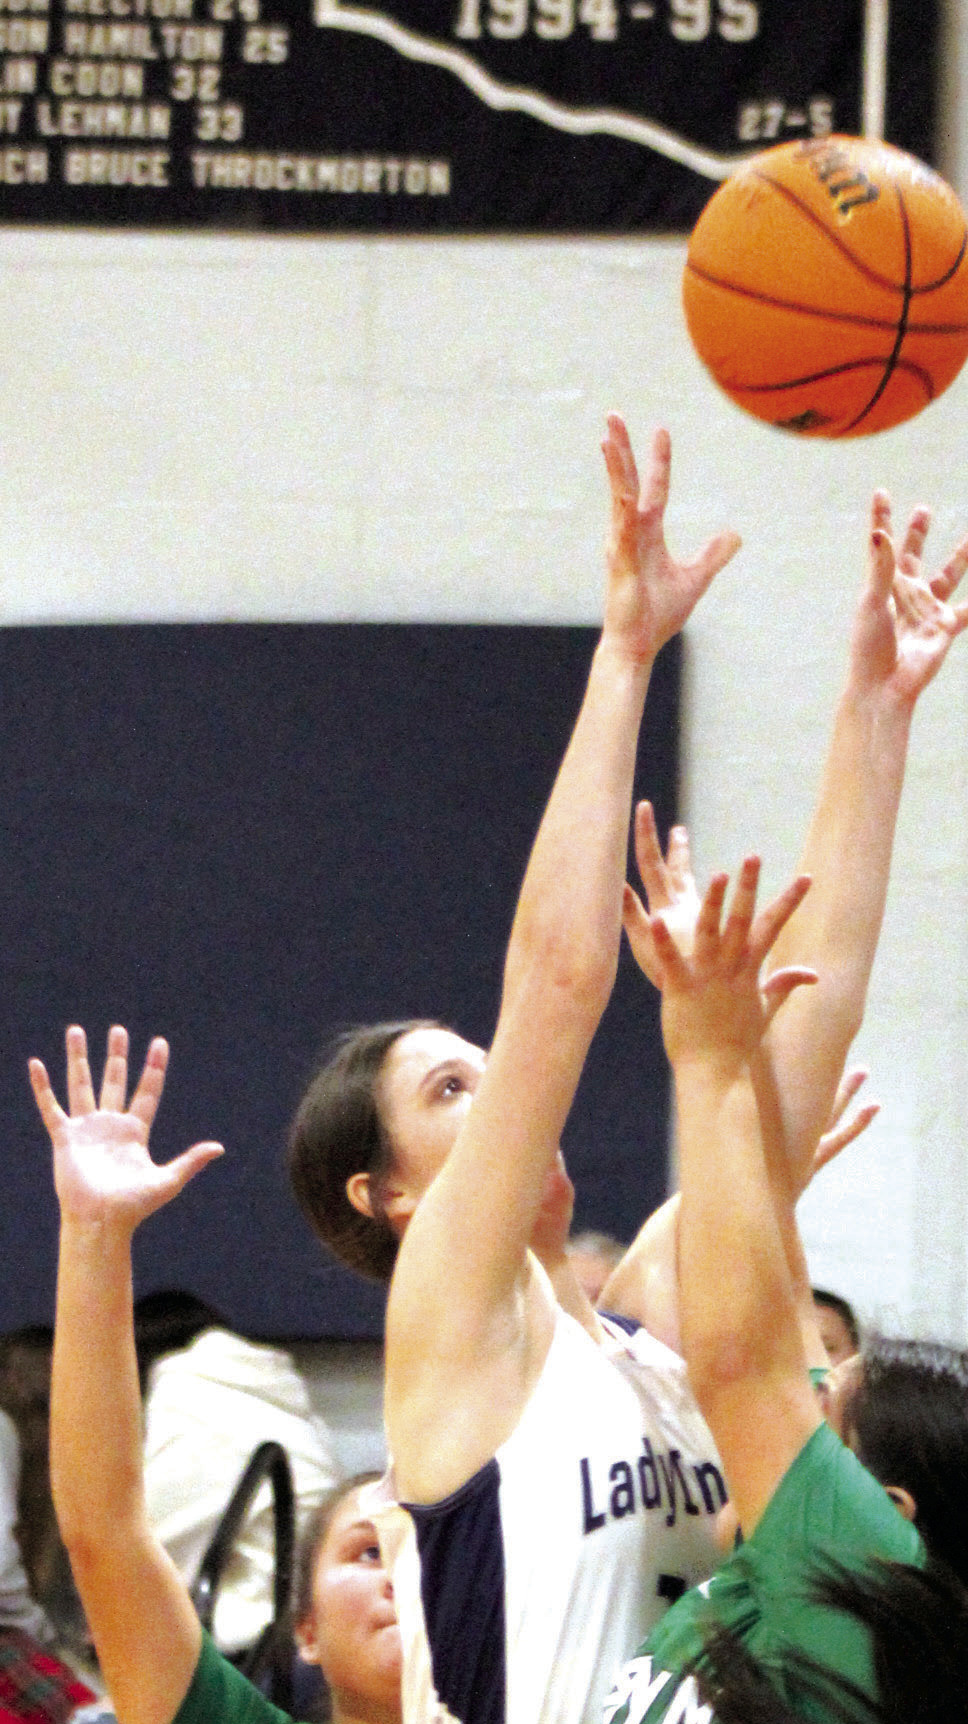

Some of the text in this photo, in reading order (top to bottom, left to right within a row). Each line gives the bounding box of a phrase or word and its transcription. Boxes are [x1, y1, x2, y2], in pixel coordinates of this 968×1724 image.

[243, 27, 288, 64] 25
[171, 65, 220, 101] 32
[37, 101, 171, 140] LEHMAN
[197, 106, 244, 142] 33
[0, 150, 450, 196] CH BRUCE THROCKMORTON
